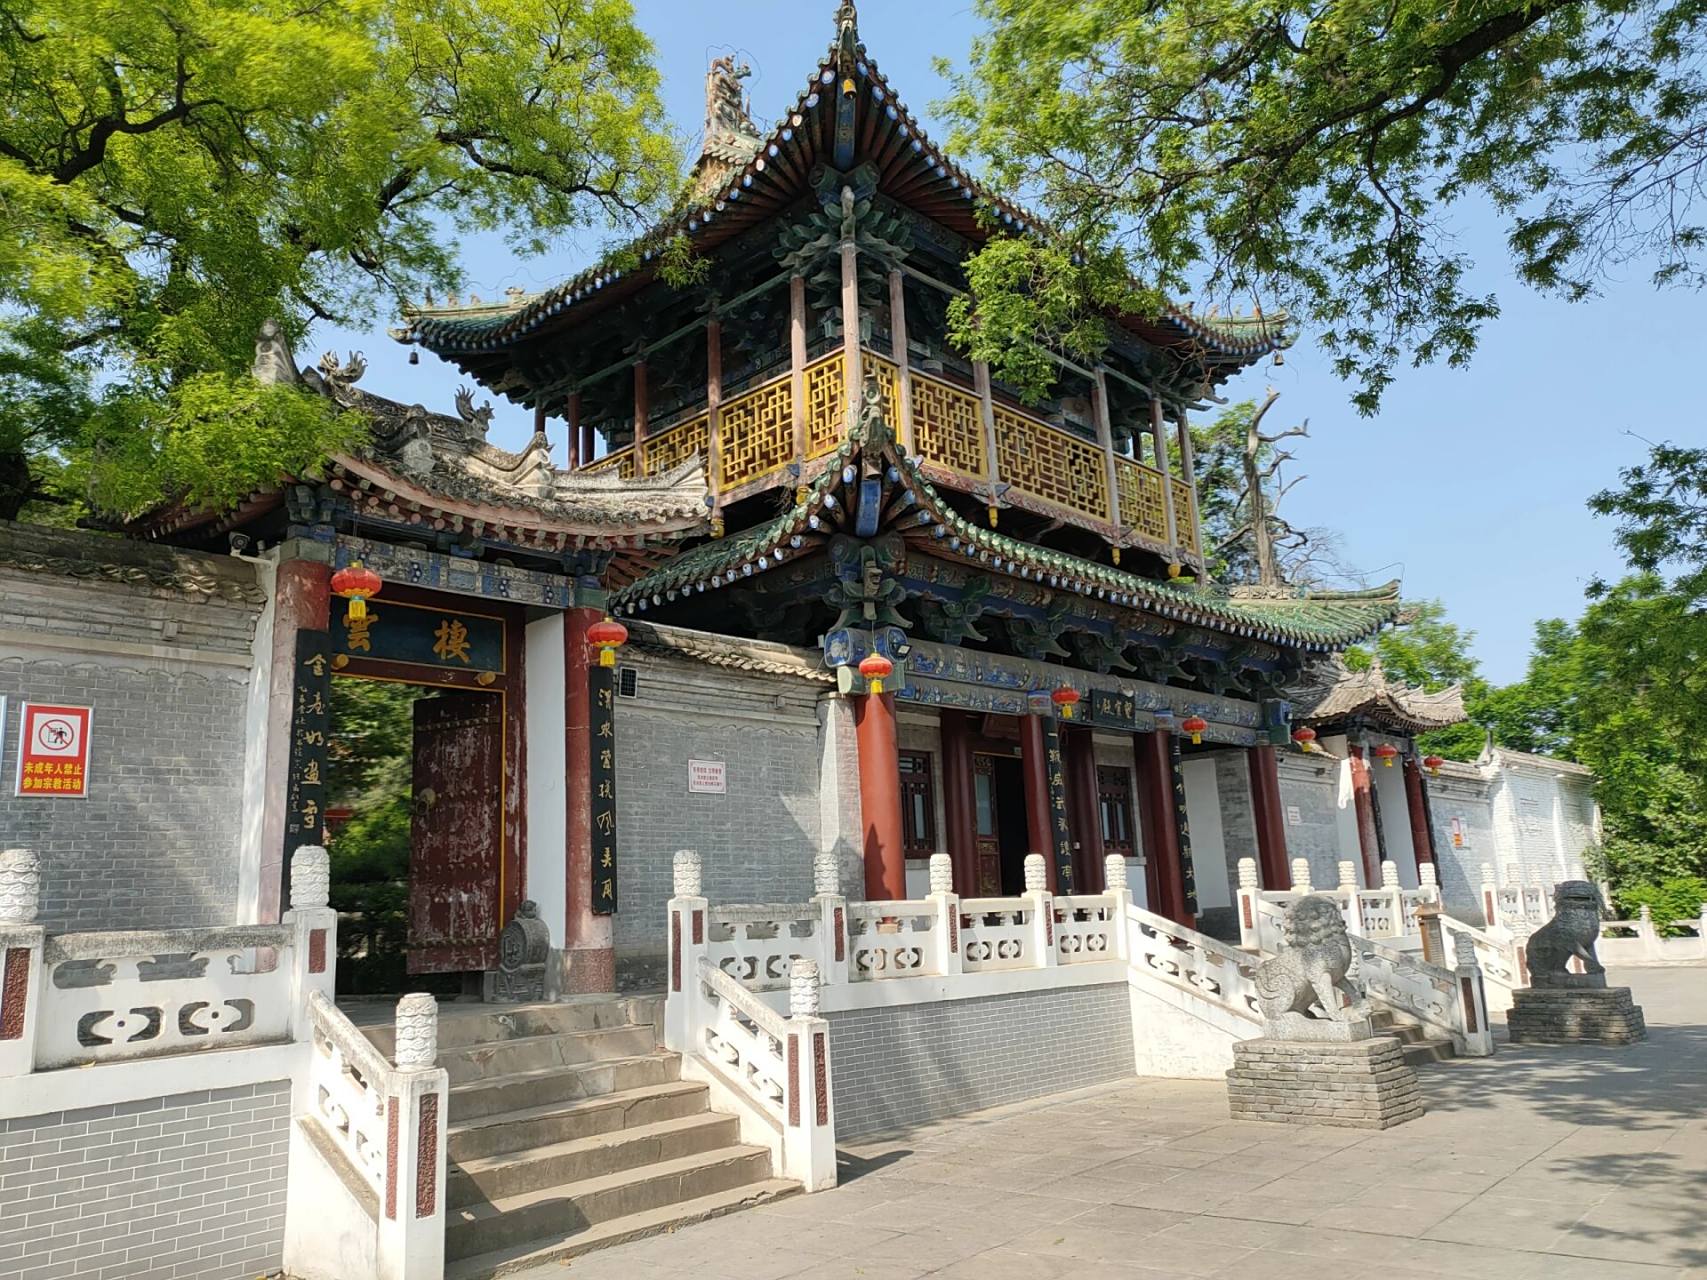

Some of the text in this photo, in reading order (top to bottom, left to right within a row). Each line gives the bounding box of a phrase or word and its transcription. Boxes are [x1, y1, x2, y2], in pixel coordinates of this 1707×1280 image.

[24, 761, 82, 775] 未成年人禁止
[23, 777, 81, 790] 参加宗教活动
